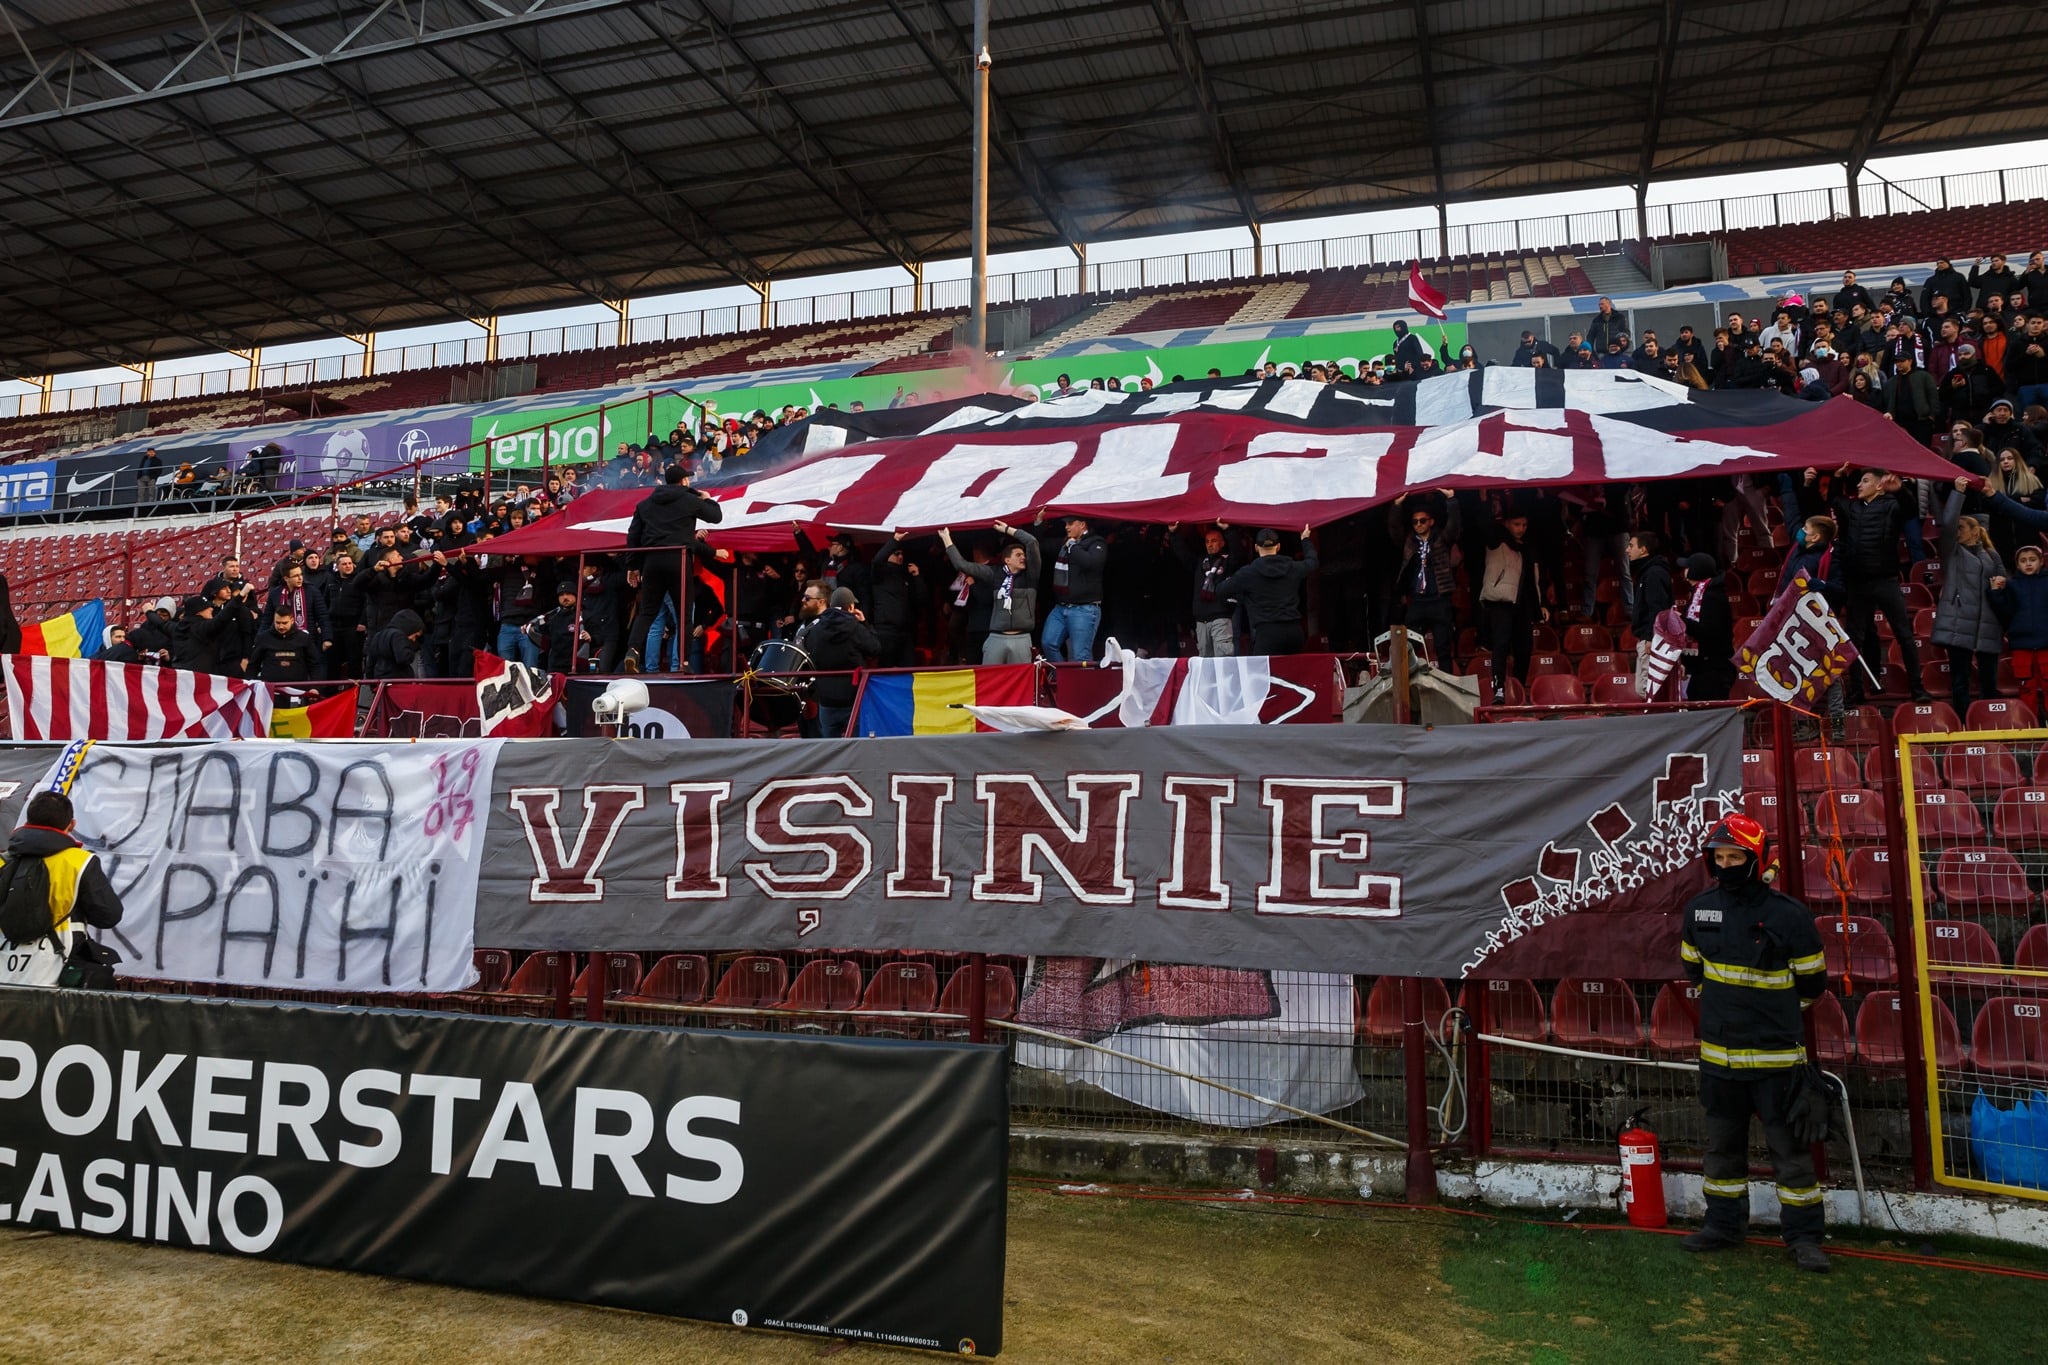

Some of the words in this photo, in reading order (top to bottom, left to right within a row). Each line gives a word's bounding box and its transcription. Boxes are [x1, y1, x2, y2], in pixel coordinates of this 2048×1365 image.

[1755, 591, 1850, 702] CFR
[7, 954, 33, 973] 07
[786, 1321, 832, 1334] RESPONSABIL.
[863, 1331, 875, 1340] NR.
